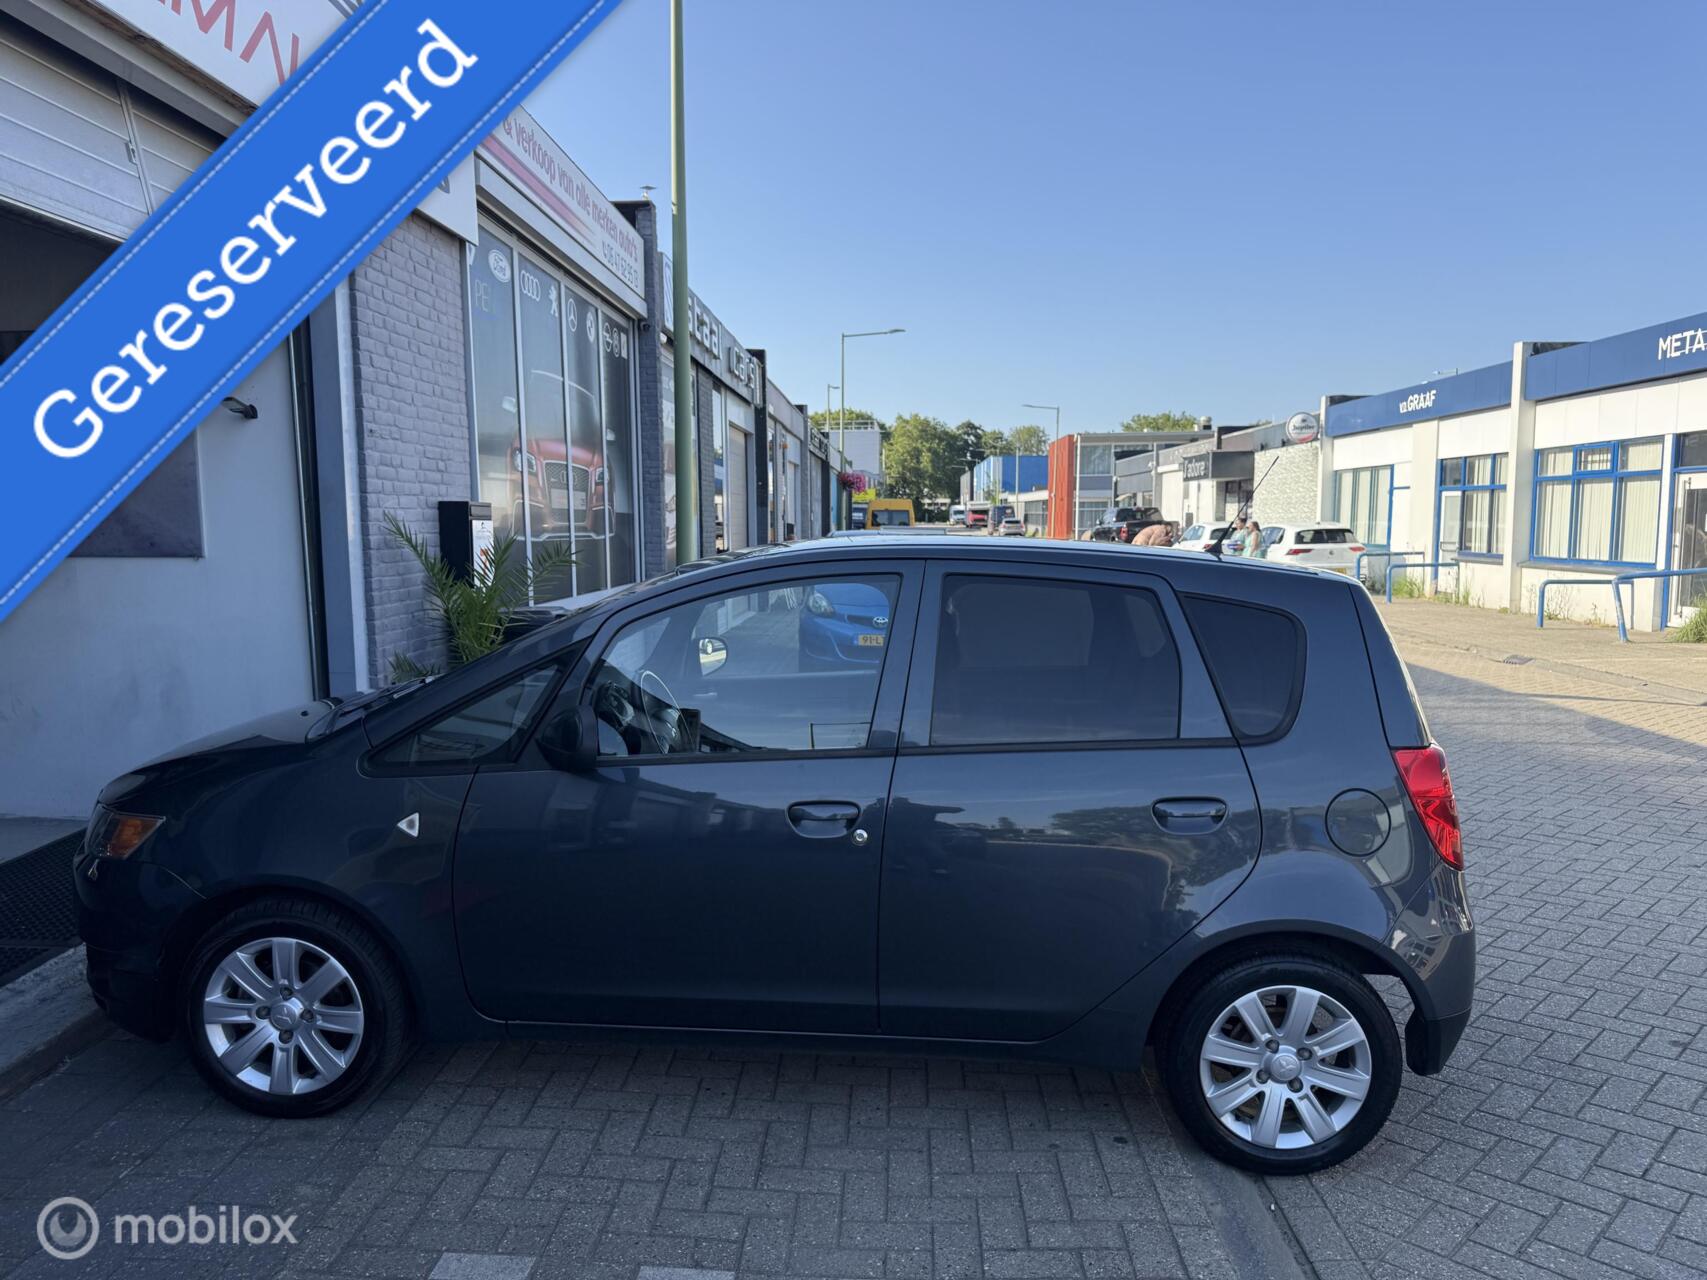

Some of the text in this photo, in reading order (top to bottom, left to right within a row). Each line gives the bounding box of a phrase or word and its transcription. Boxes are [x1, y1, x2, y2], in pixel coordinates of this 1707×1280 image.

[514, 118, 556, 184] verkoop
[557, 163, 574, 200] van
[1407, 389, 1437, 412] GRAAF
